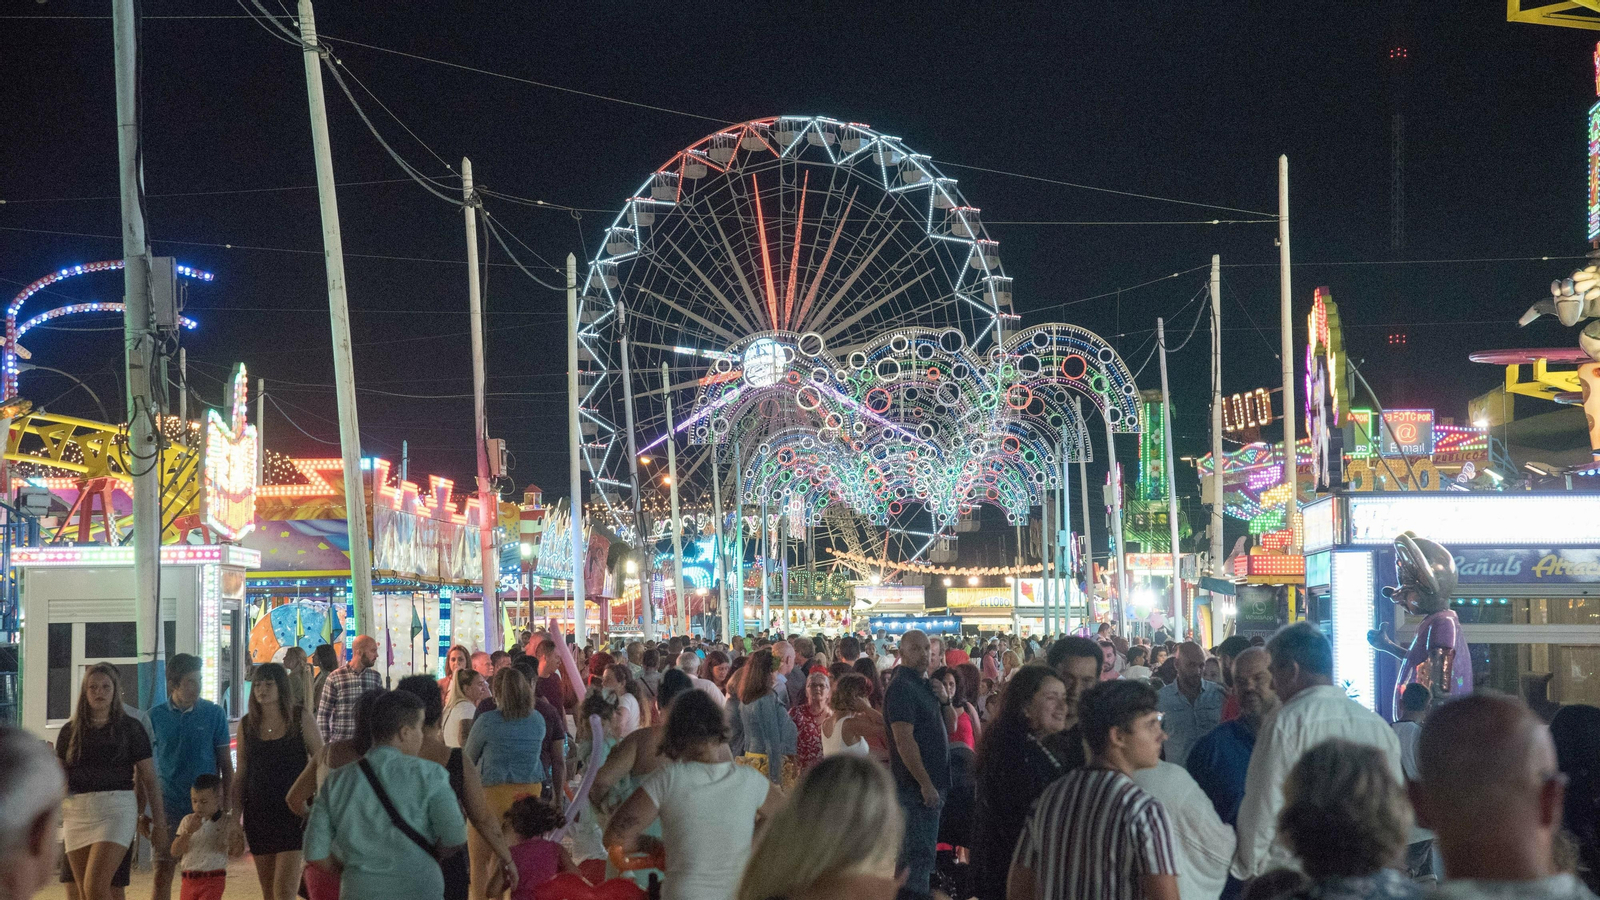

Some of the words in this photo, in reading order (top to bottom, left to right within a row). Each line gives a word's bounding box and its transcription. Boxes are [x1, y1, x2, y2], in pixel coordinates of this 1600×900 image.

[1222, 387, 1268, 432] LOCO
[1417, 413, 1431, 421] POR
[1390, 442, 1425, 453] Email
[1435, 451, 1488, 462] PUBLICOS
[980, 599, 988, 607] EL
[990, 596, 1010, 607] LOBO
